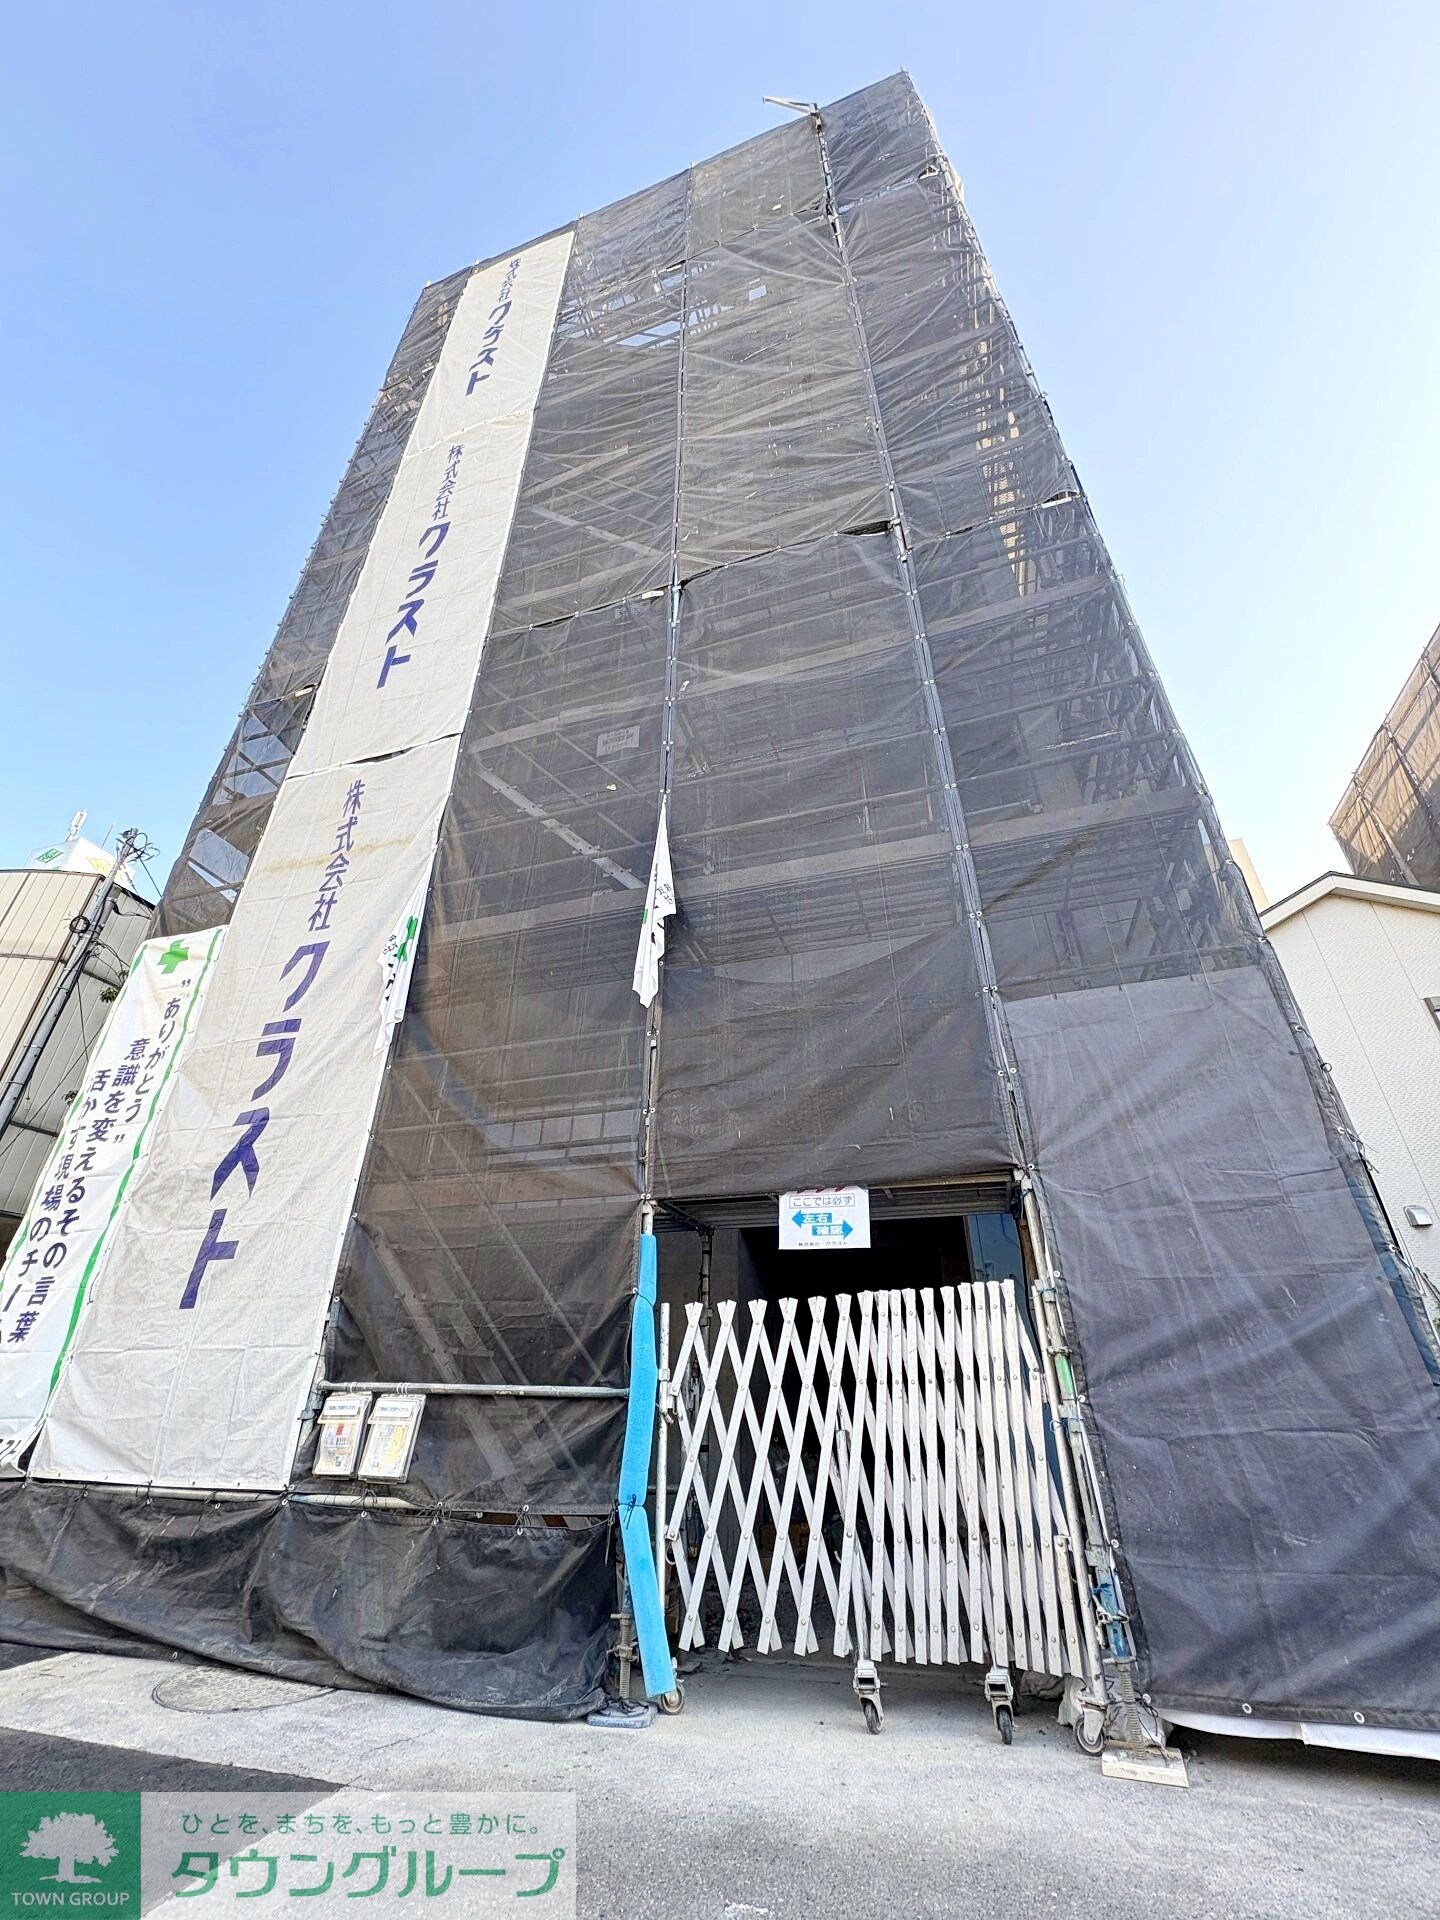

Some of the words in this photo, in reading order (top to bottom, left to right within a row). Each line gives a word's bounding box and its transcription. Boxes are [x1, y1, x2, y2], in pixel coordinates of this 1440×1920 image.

[8, 1038, 150, 1343] 意識を変えるその言葉
[793, 1195, 852, 1207] ここでは必ず
[802, 1213, 830, 1223] 左右
[816, 1225, 844, 1236] 確認
